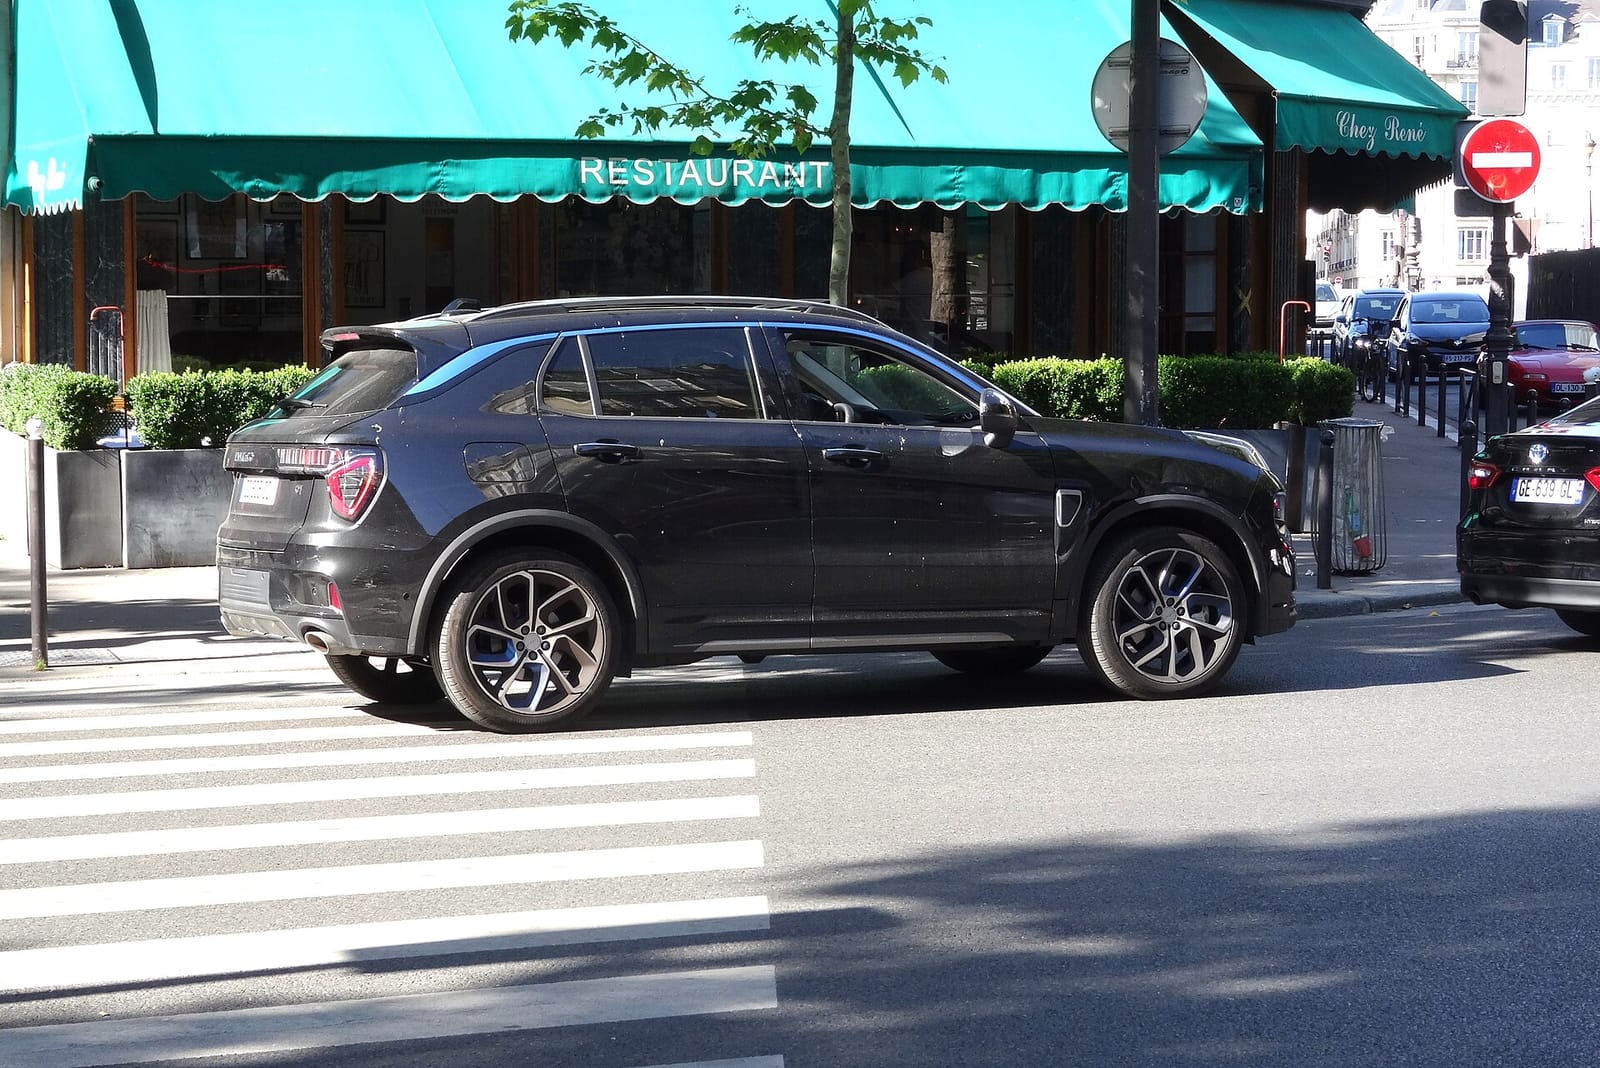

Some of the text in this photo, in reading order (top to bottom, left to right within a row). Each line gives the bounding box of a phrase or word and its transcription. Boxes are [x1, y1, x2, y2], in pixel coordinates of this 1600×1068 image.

[1336, 110, 1427, 151] Chez René
[580, 156, 830, 189] RESTAURANT
[1518, 479, 1572, 499] GE-639-GL
